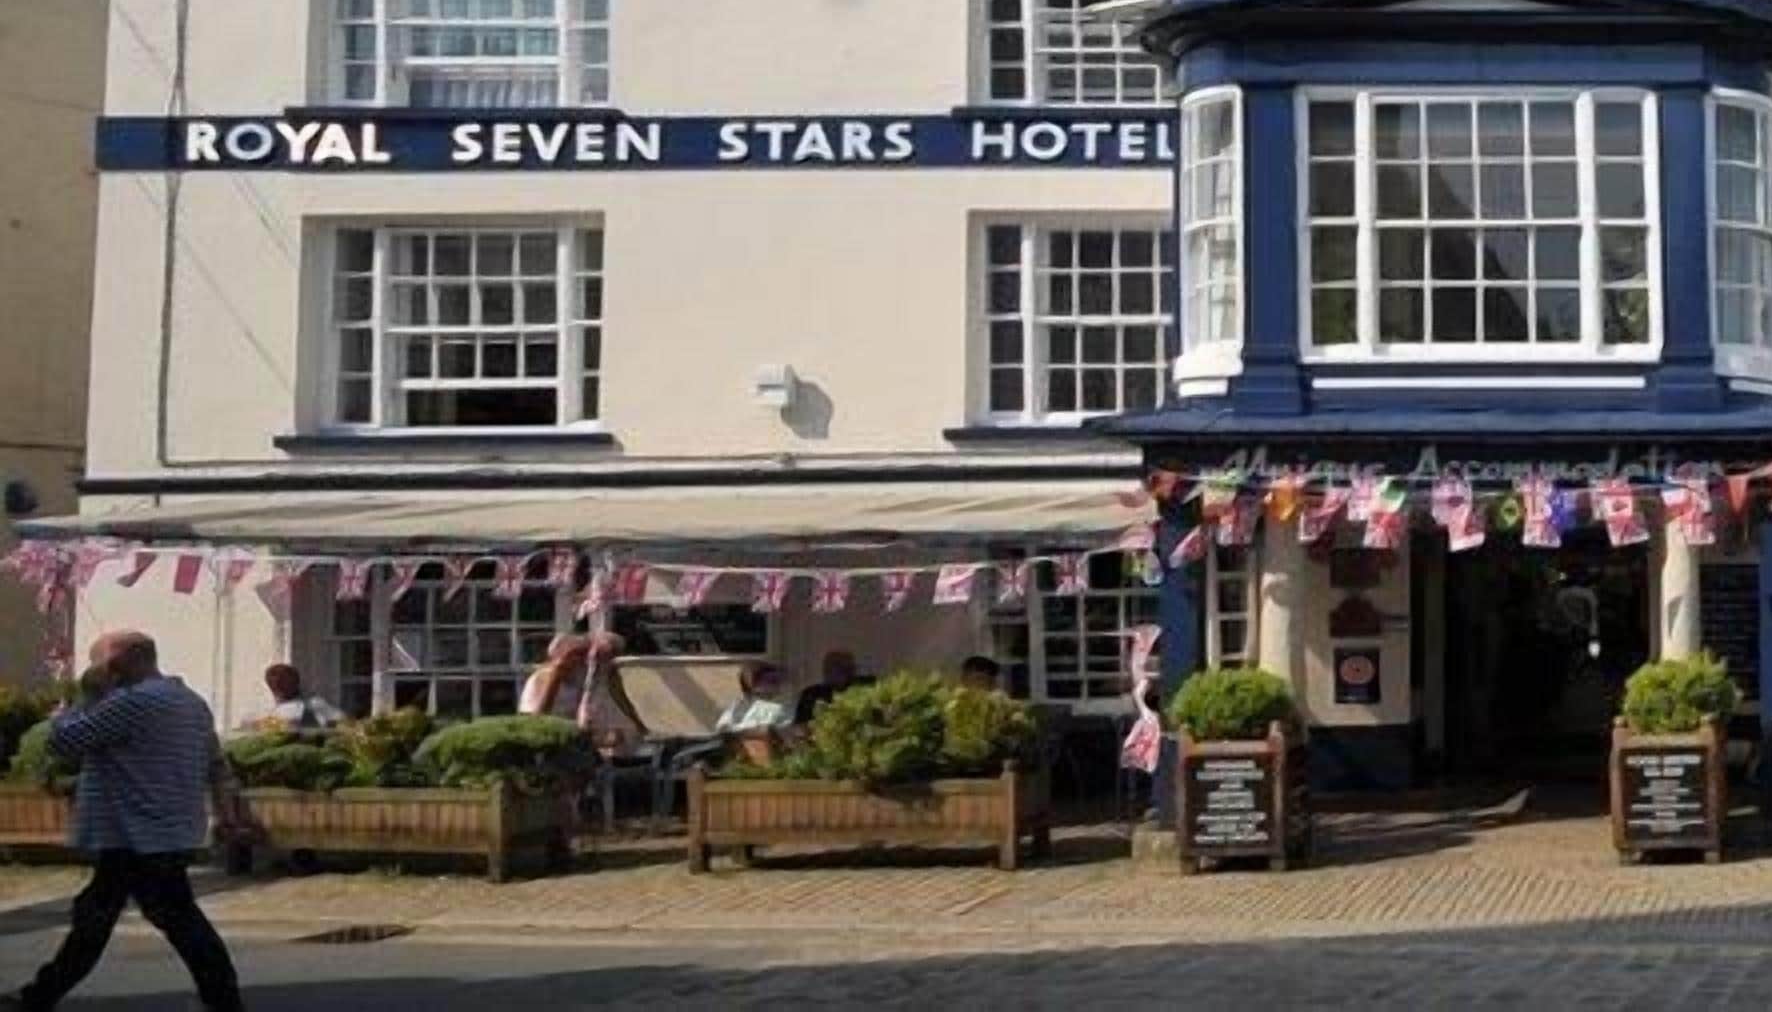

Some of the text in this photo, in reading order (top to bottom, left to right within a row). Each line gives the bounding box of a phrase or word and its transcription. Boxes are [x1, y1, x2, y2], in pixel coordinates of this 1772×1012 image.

[184, 121, 1175, 164] ROYAL SEVEN STARS HOTEL
